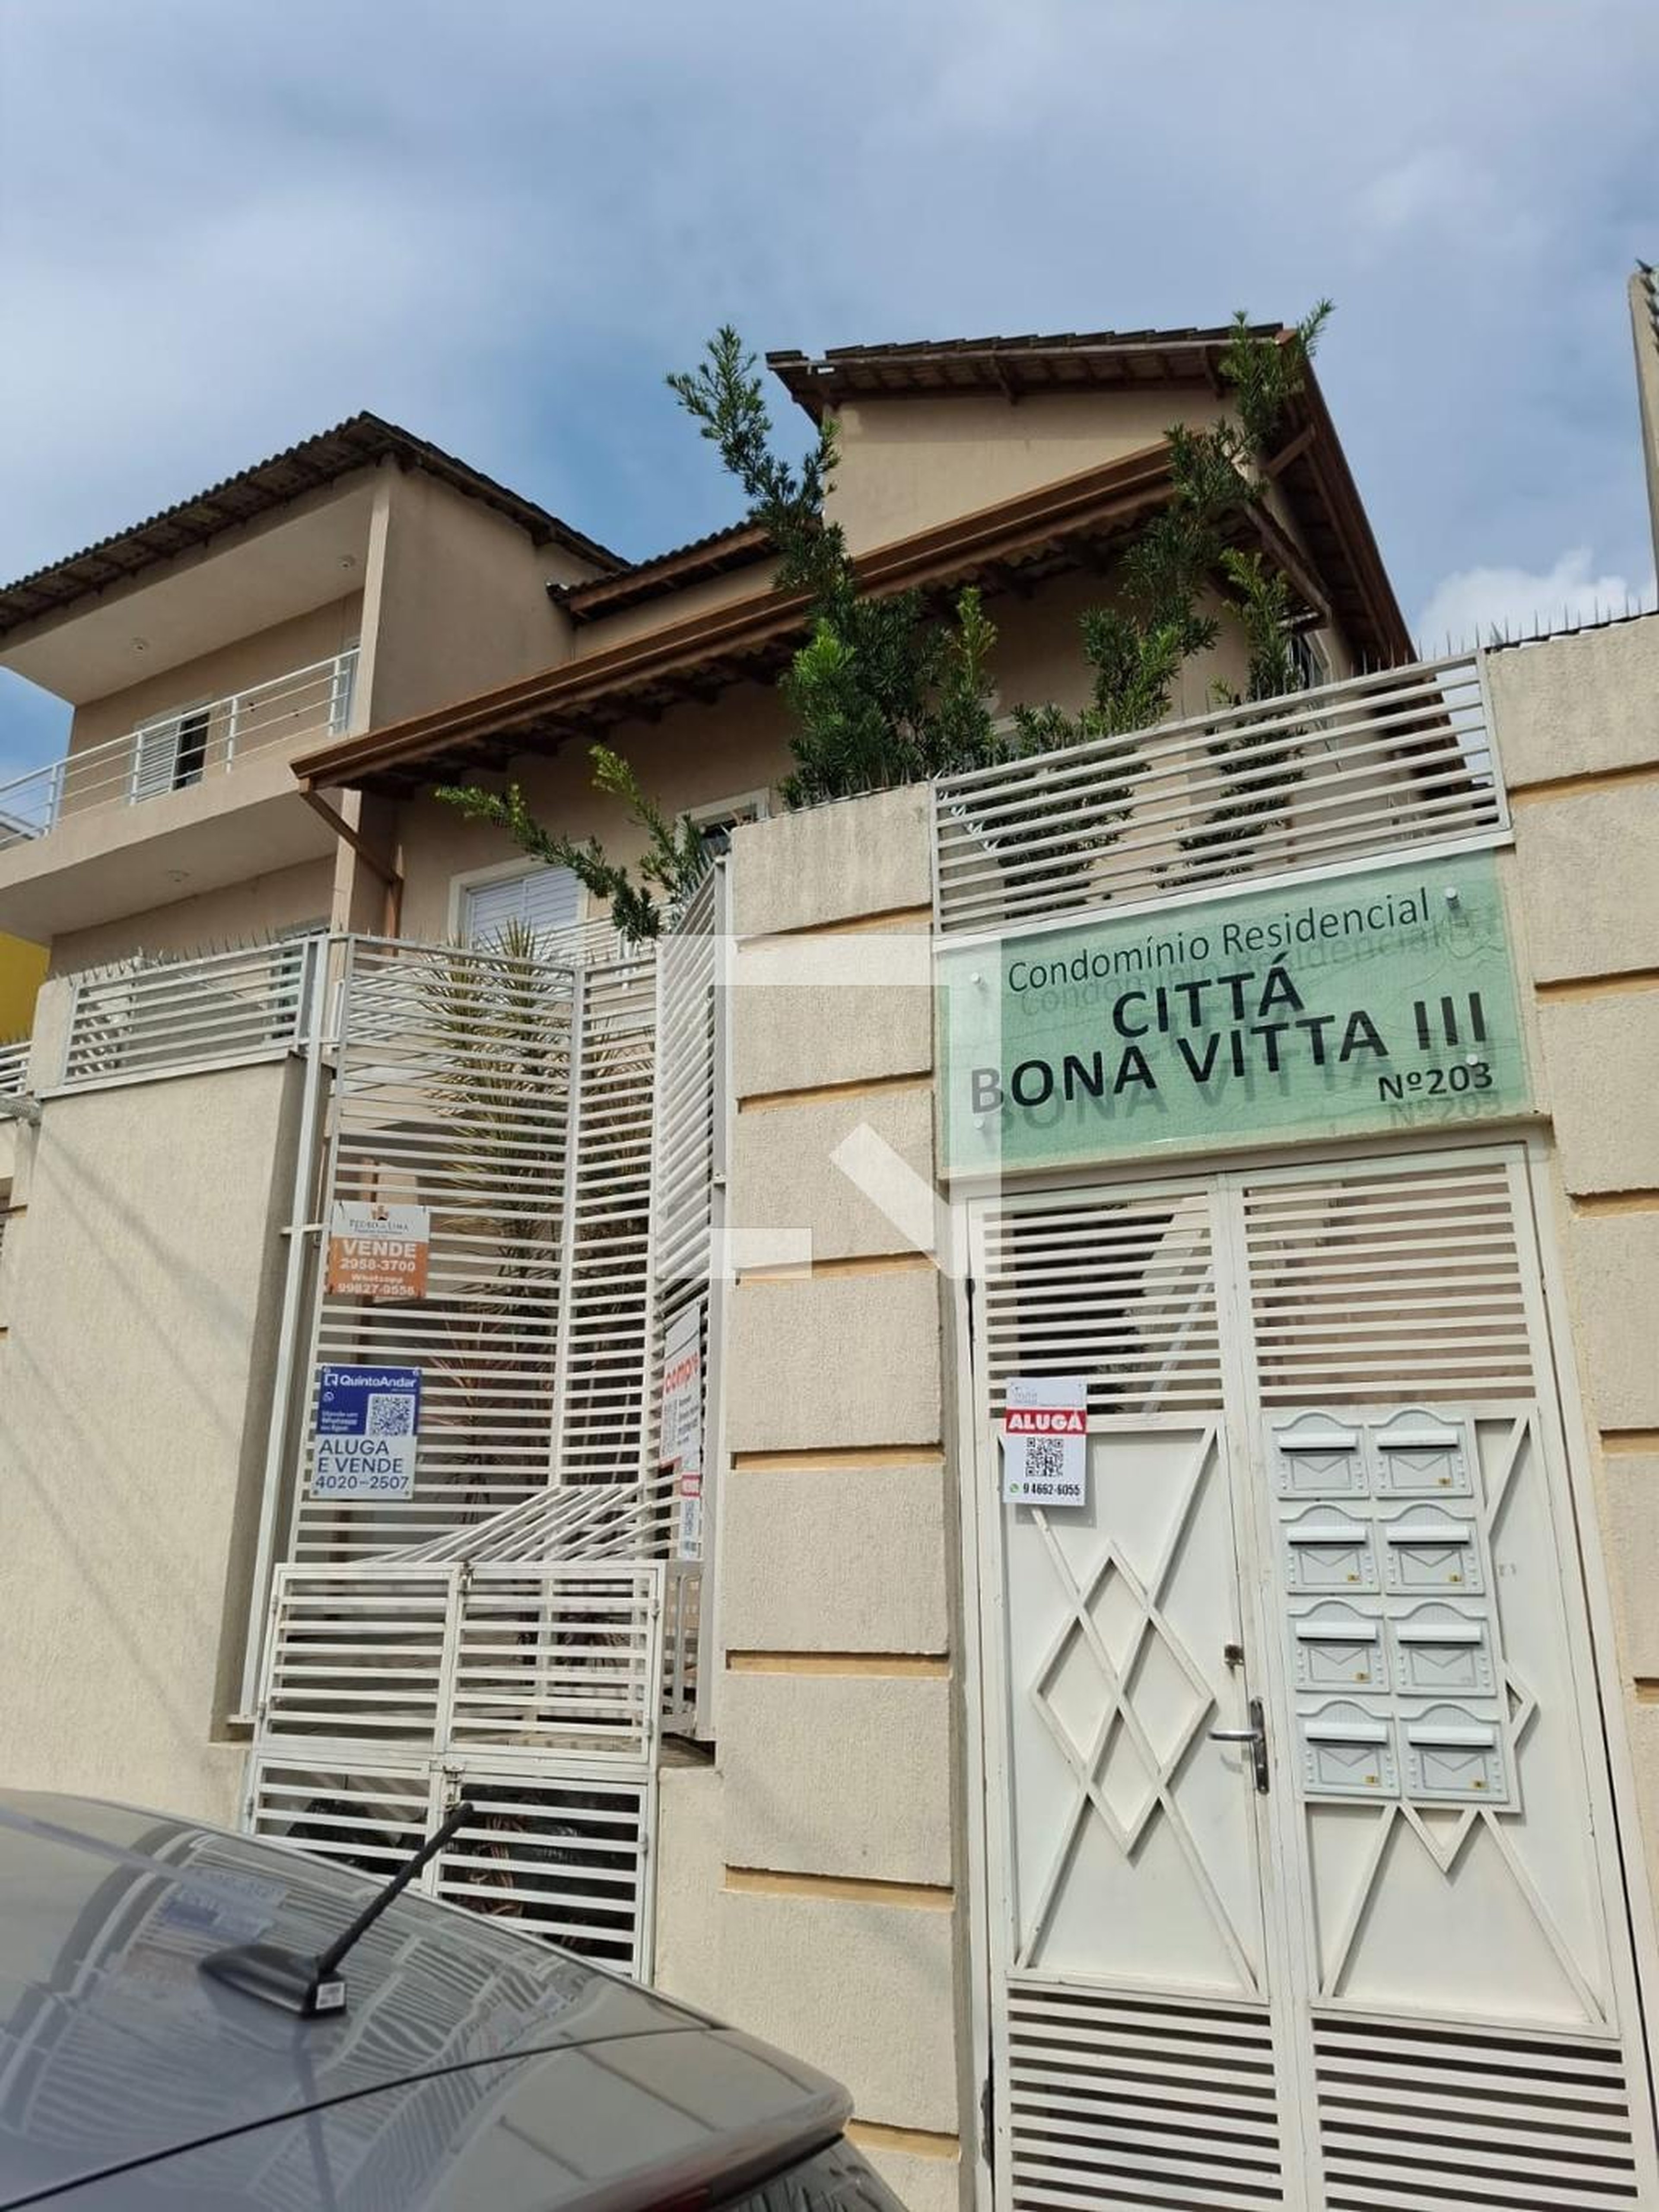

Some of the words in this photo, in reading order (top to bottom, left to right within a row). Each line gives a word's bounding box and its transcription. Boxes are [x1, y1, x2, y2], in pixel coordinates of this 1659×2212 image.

[1009, 932, 1209, 993] Condomínio
[1223, 887, 1430, 952] Residencial
[1113, 953, 1305, 1037] CITTÁ
[971, 1046, 1158, 1114] BONA
[1177, 1010, 1390, 1083] VITTA
[1413, 992, 1487, 1050] III
[343, 1239, 416, 1258] VENDE
[340, 1375, 417, 1388] QuintoAndar
[1008, 1413, 1083, 1431] ALUGA
[319, 1439, 389, 1455] ALUGA
[319, 1457, 329, 1473] E
[335, 1458, 403, 1473] VENDE
[315, 1476, 409, 1489] 4020-2507
